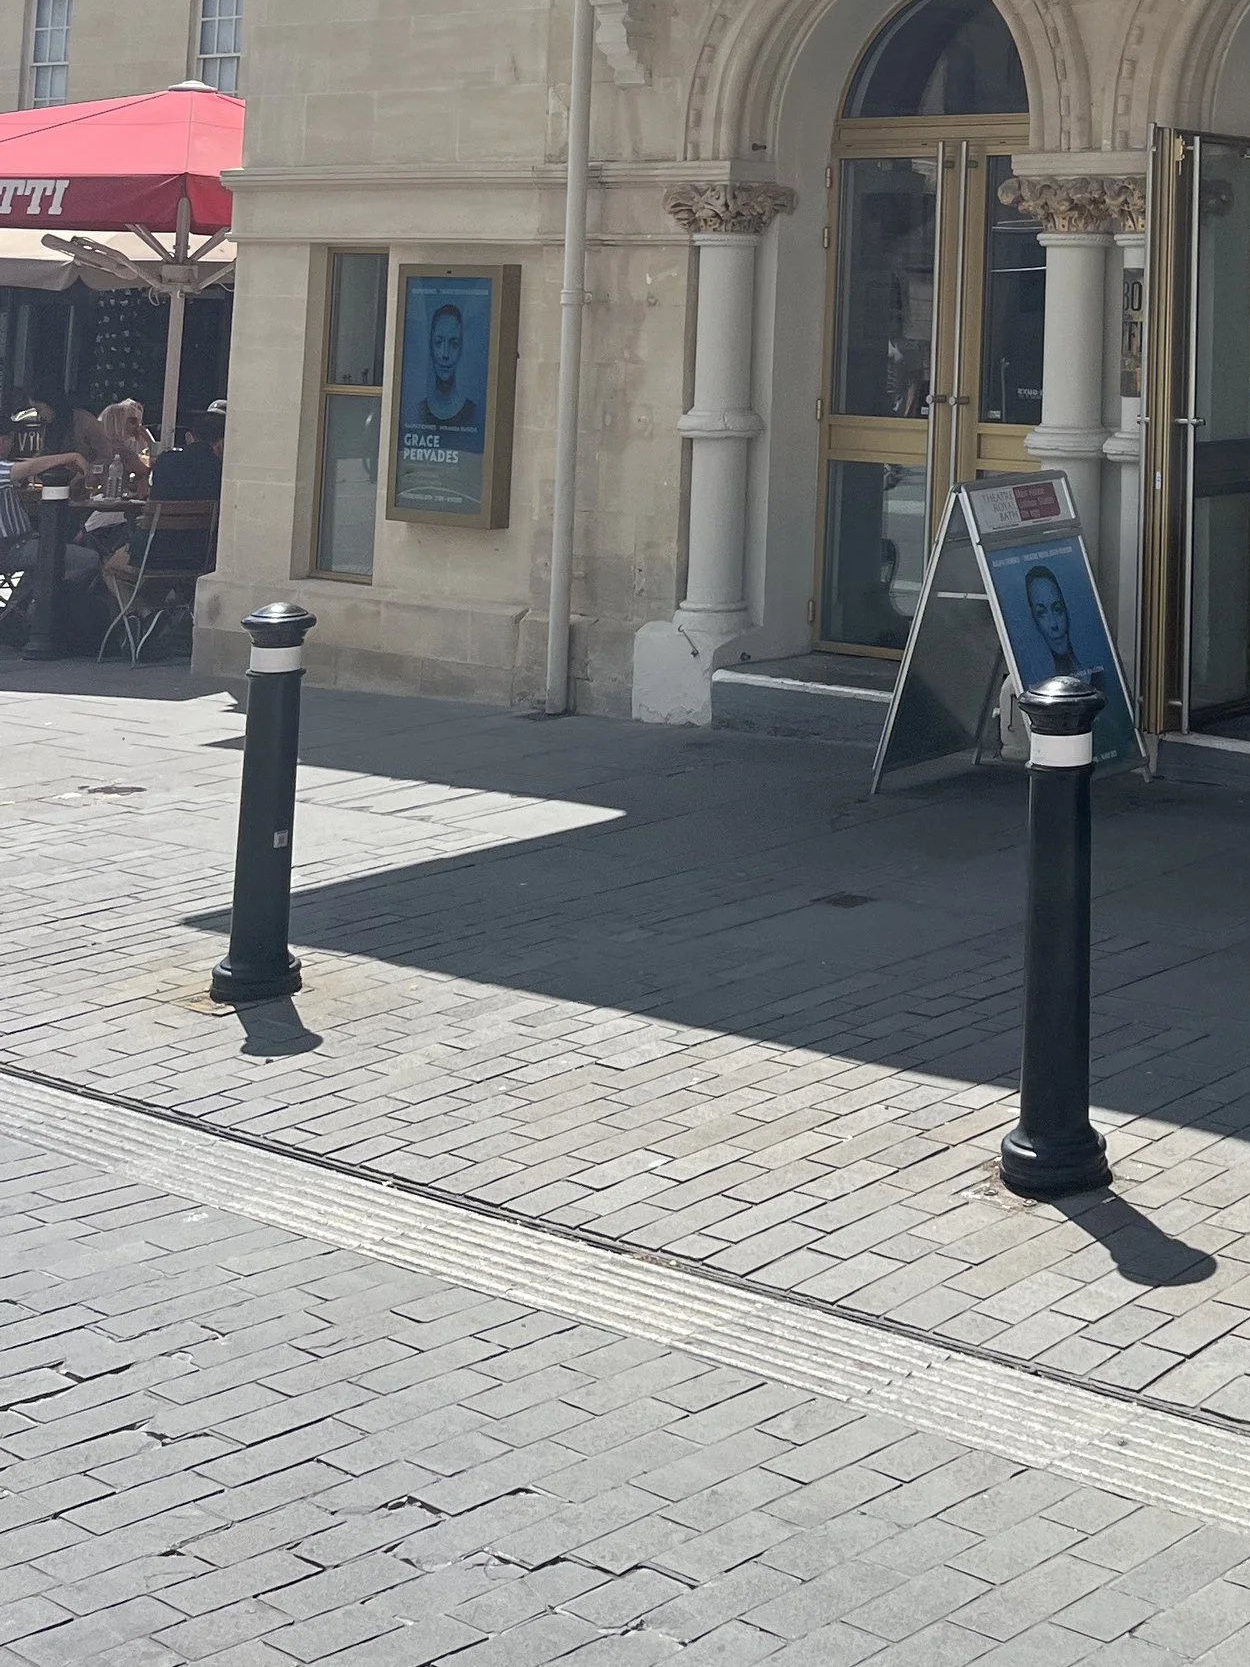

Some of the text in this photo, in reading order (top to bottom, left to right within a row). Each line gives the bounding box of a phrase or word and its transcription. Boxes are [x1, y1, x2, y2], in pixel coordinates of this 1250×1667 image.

[0, 179, 70, 215] TTI
[1122, 280, 1143, 312] BO
[403, 433, 440, 448] GRACE
[403, 447, 459, 464] PERVADES
[982, 490, 1013, 503] THEATRE
[1000, 510, 1019, 522] BATH
